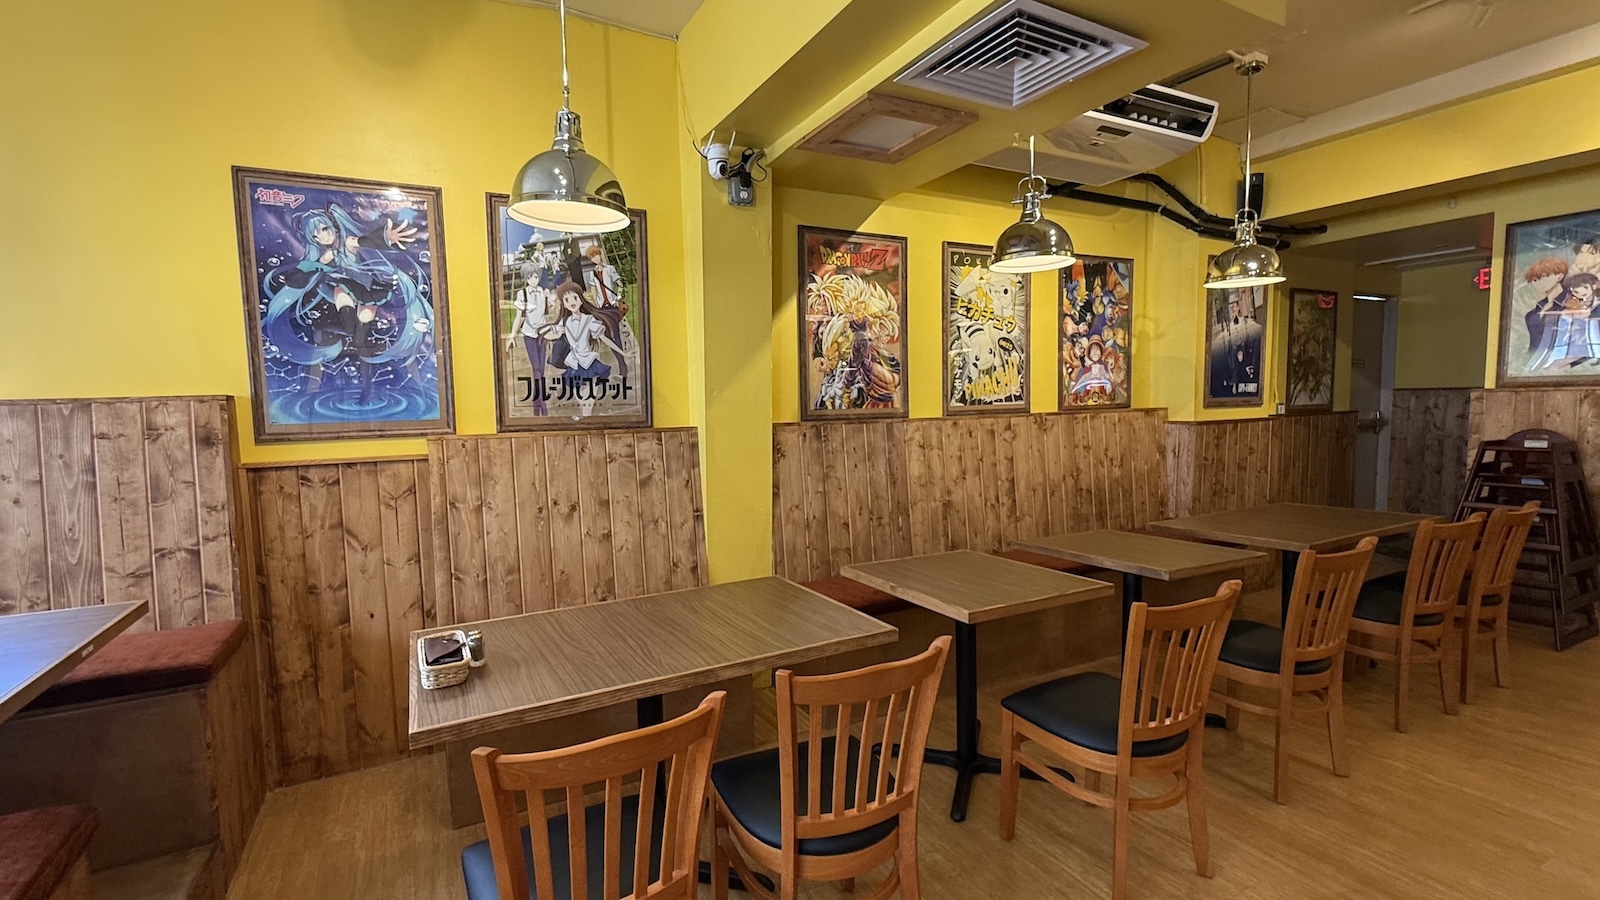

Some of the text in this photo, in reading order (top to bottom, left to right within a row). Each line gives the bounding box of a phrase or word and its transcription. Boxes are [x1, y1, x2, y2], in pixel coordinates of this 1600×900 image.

[255, 187, 305, 209] 初音ミク
[819, 244, 851, 267] DRAGON
[867, 249, 888, 271] Z
[1480, 267, 1491, 290] E
[956, 297, 1017, 334] ピカチュウ
[964, 351, 1019, 400] PIKACHU
[517, 376, 633, 402] フルーツバスケット
